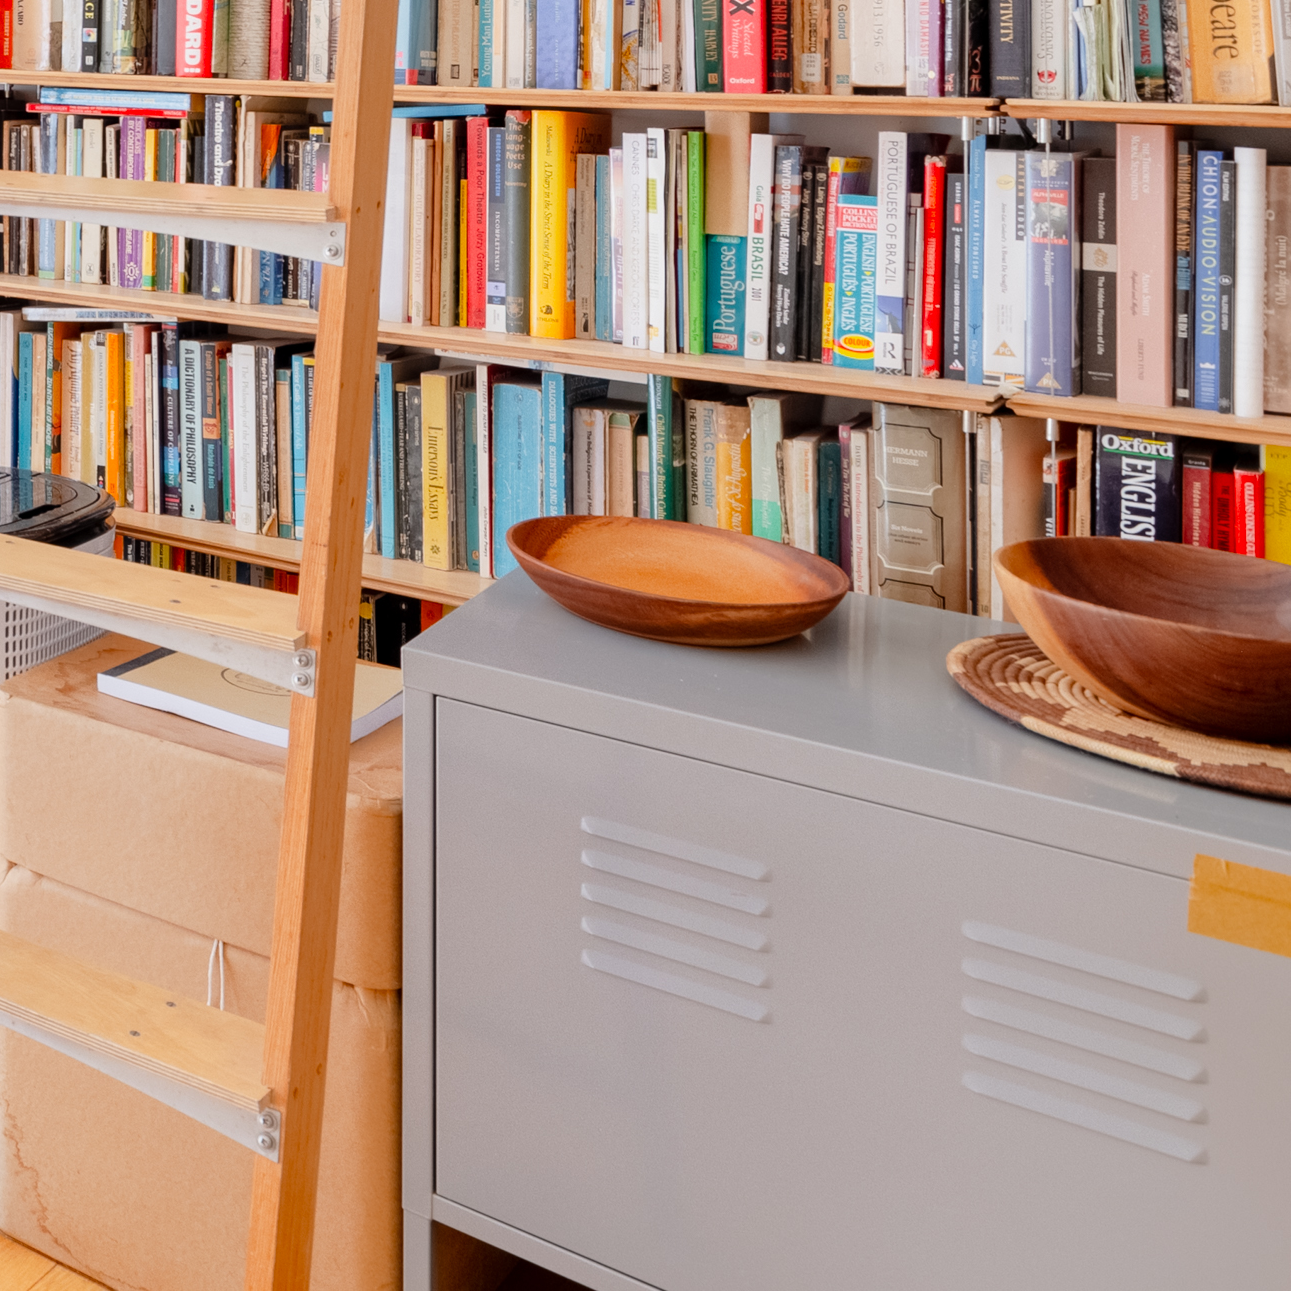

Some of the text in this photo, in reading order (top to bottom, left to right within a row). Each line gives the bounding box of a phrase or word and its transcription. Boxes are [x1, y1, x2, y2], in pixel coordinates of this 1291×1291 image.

[482, 25, 491, 46] Man
[732, 19, 741, 58] Writings
[743, 19, 754, 56] Selected
[838, 2, 848, 40] Godard
[772, 22, 787, 61] ALLEG
[482, 48, 491, 77] Young
[1203, 155, 1217, 209] CHION
[885, 140, 898, 284] PORTUGUESE OF BRAZIL
[752, 237, 764, 281] BRASIL
[713, 246, 744, 332] Portuguese
[841, 233, 857, 331] PORTUGUÊS INGLÊS
[861, 234, 875, 333] ENGLISH PORTUGUESE
[844, 338, 871, 347] COLOUR
[184, 348, 196, 484] A DICTIONARY OF PHILOSOPHY
[703, 408, 714, 439] Frank
[886, 446, 927, 458] HERMANN
[892, 457, 919, 467] HESSE
[1101, 434, 1174, 457] Oxford
[703, 455, 715, 509] Slaughter
